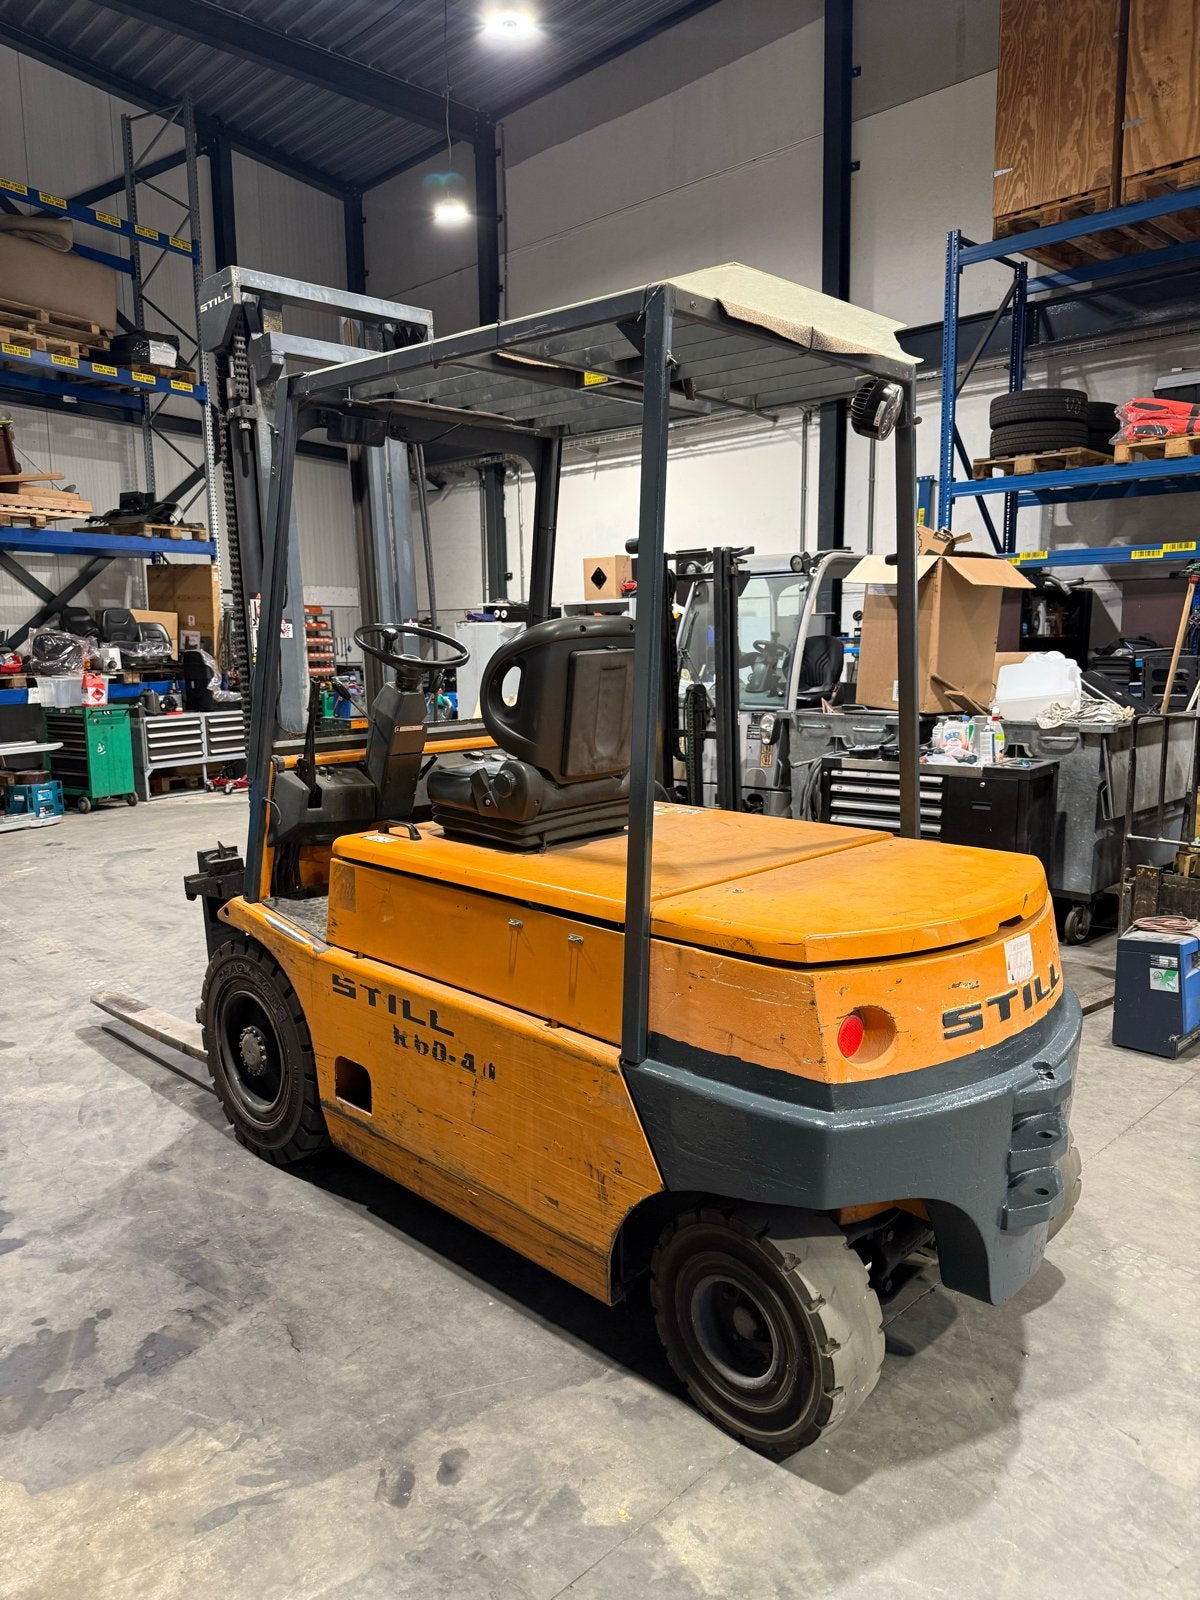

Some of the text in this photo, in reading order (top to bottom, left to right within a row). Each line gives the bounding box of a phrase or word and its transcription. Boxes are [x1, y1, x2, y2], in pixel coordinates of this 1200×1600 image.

[199, 292, 232, 313] STILL
[332, 973, 455, 1037] STILL
[942, 963, 1060, 1040] STILL
